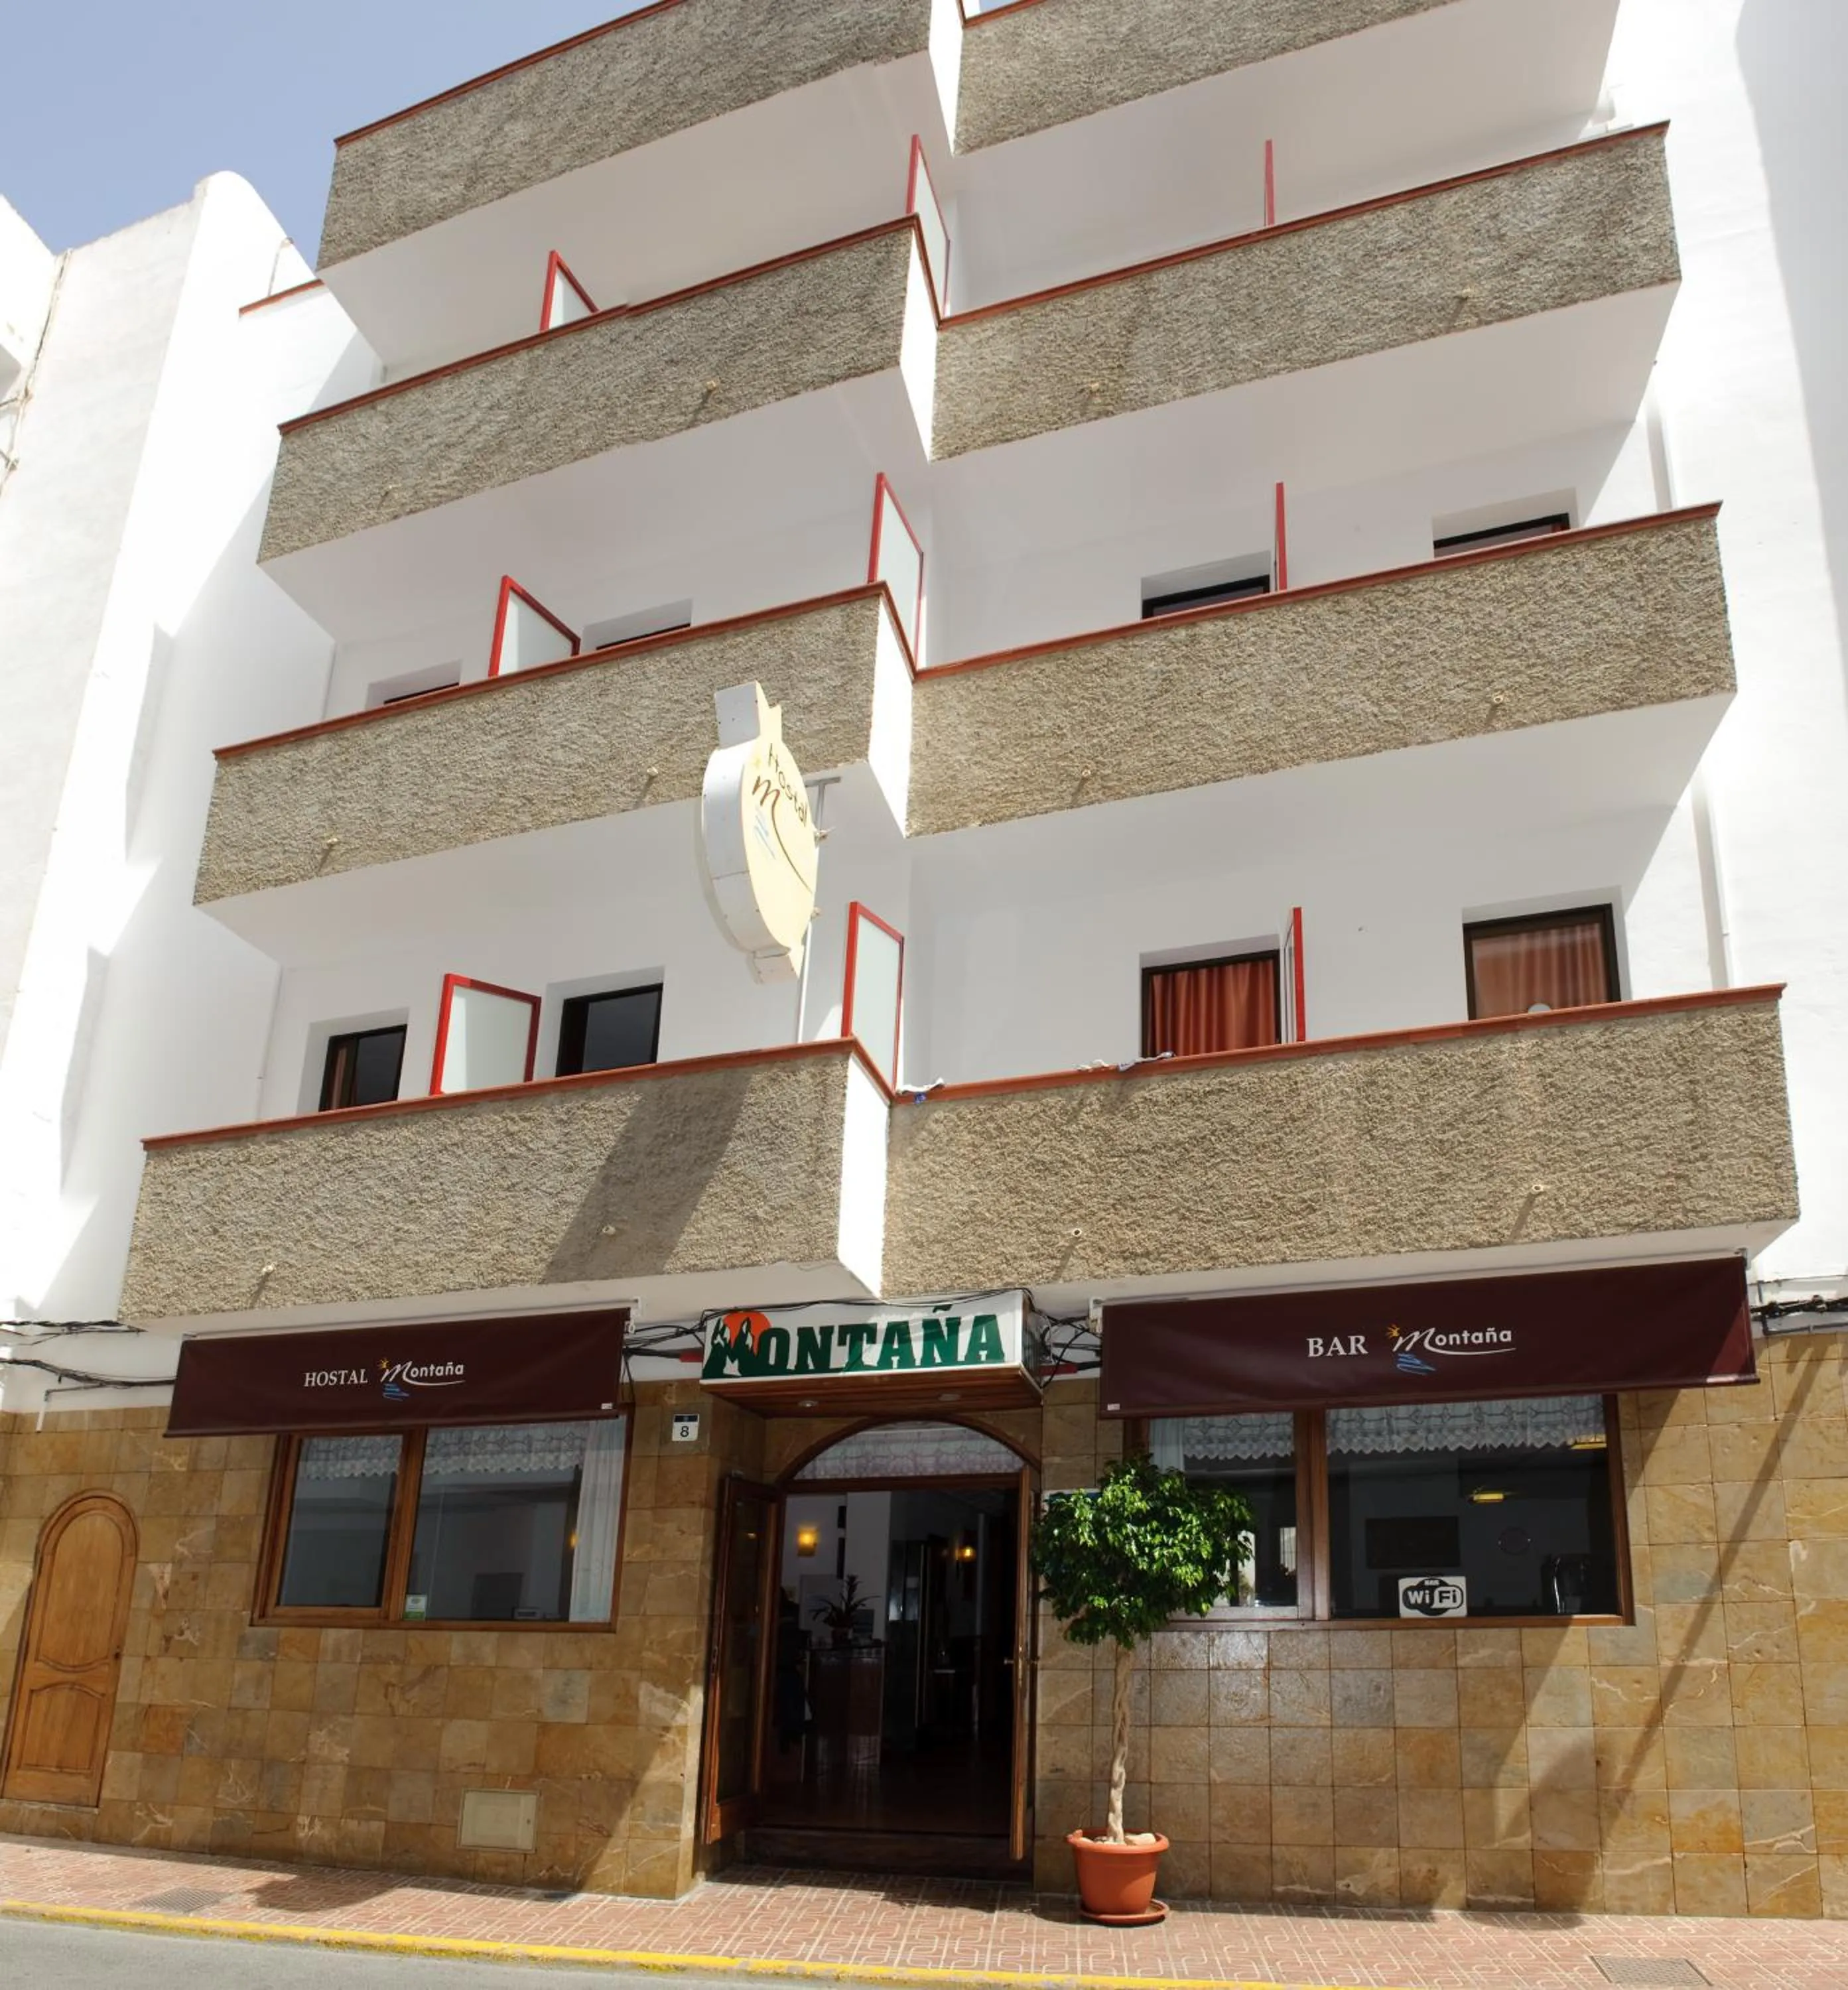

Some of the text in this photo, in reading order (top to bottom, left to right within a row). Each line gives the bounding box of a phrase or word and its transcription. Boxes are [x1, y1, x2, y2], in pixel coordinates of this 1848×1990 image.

[702, 1303, 1005, 1380] MONTAÑA
[1306, 1327, 1517, 1358] BAR Montaña
[302, 1360, 465, 1387] HOSTAL Montaña
[680, 1425, 689, 1437] 8
